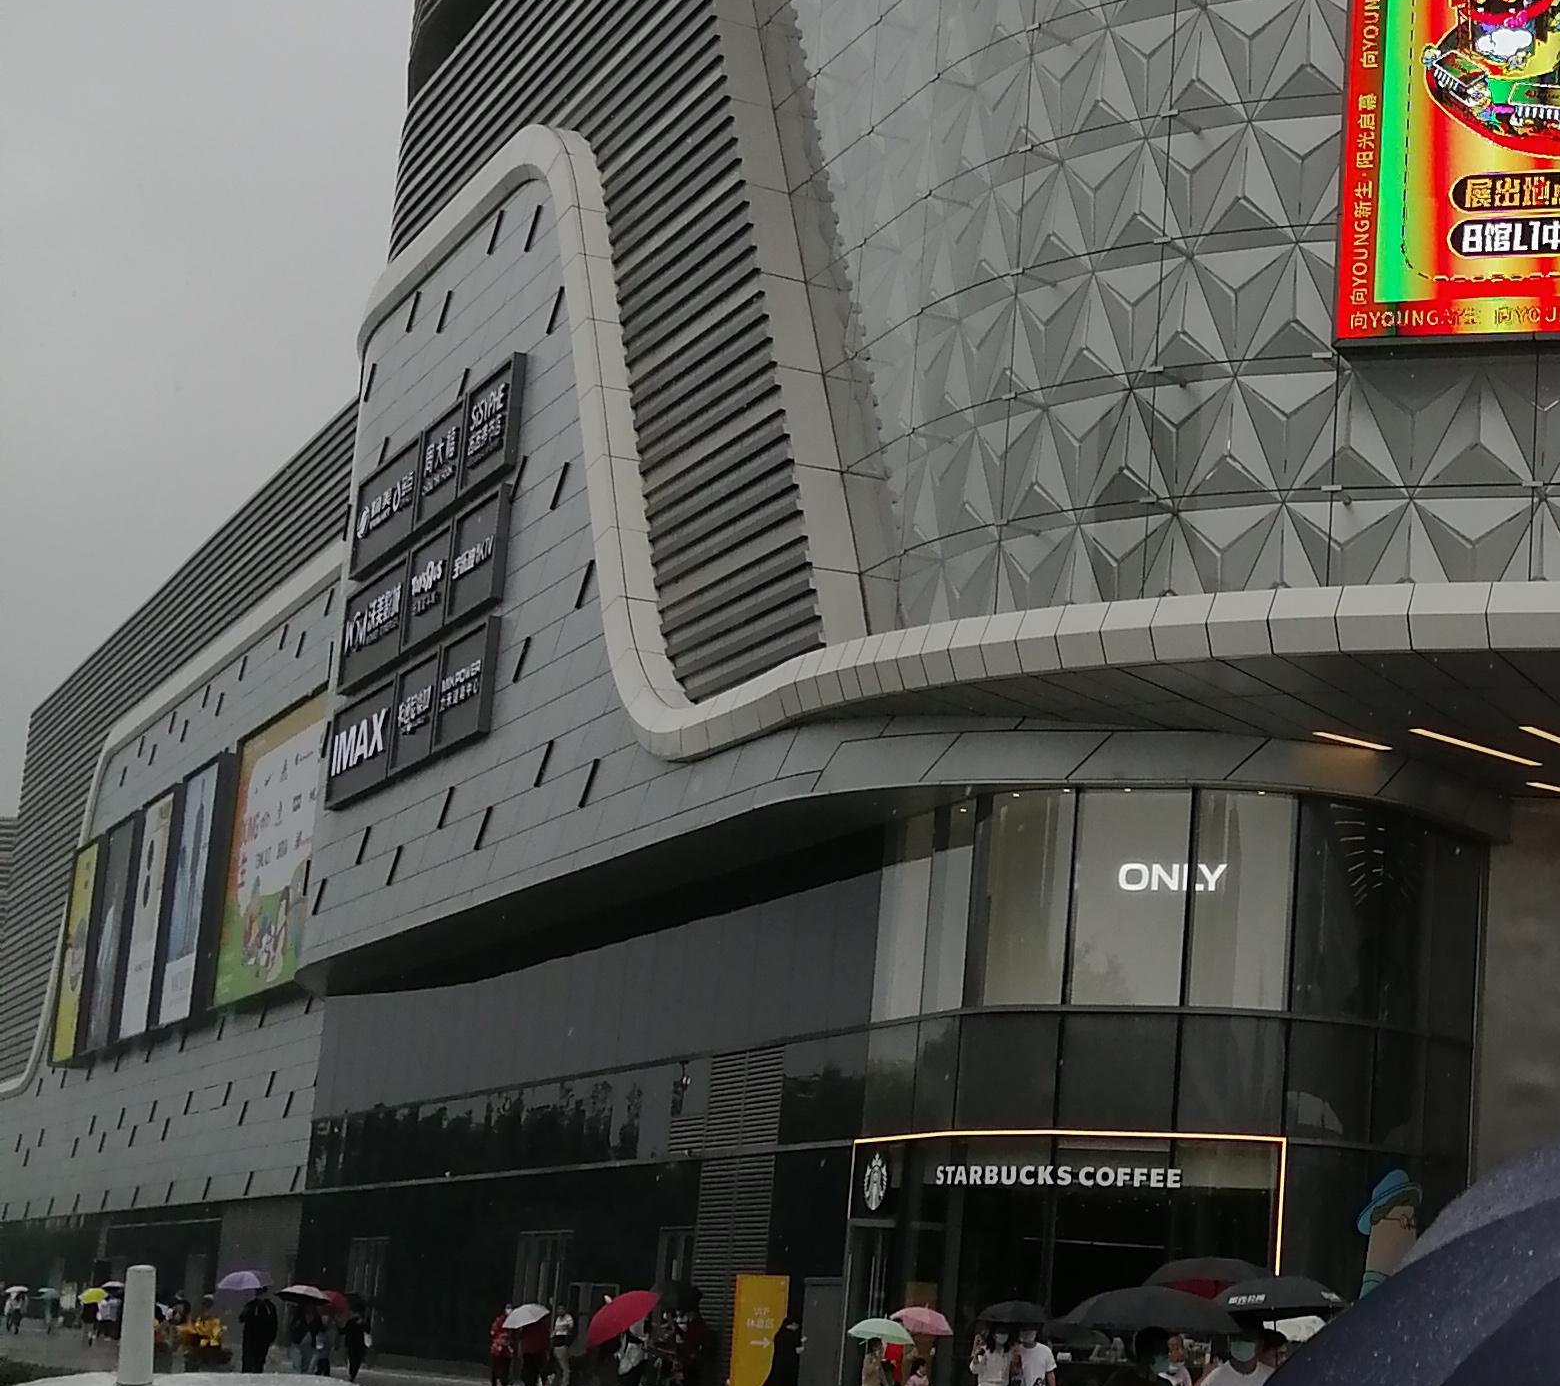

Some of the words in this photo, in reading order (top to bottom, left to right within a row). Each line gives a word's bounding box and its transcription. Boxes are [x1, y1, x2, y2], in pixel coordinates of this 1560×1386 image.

[330, 707, 388, 777] IMAX
[1117, 861, 1228, 892] ONLY
[935, 1164, 1073, 1187] STARBUCKS
[1079, 1165, 1182, 1190] COFFEE
